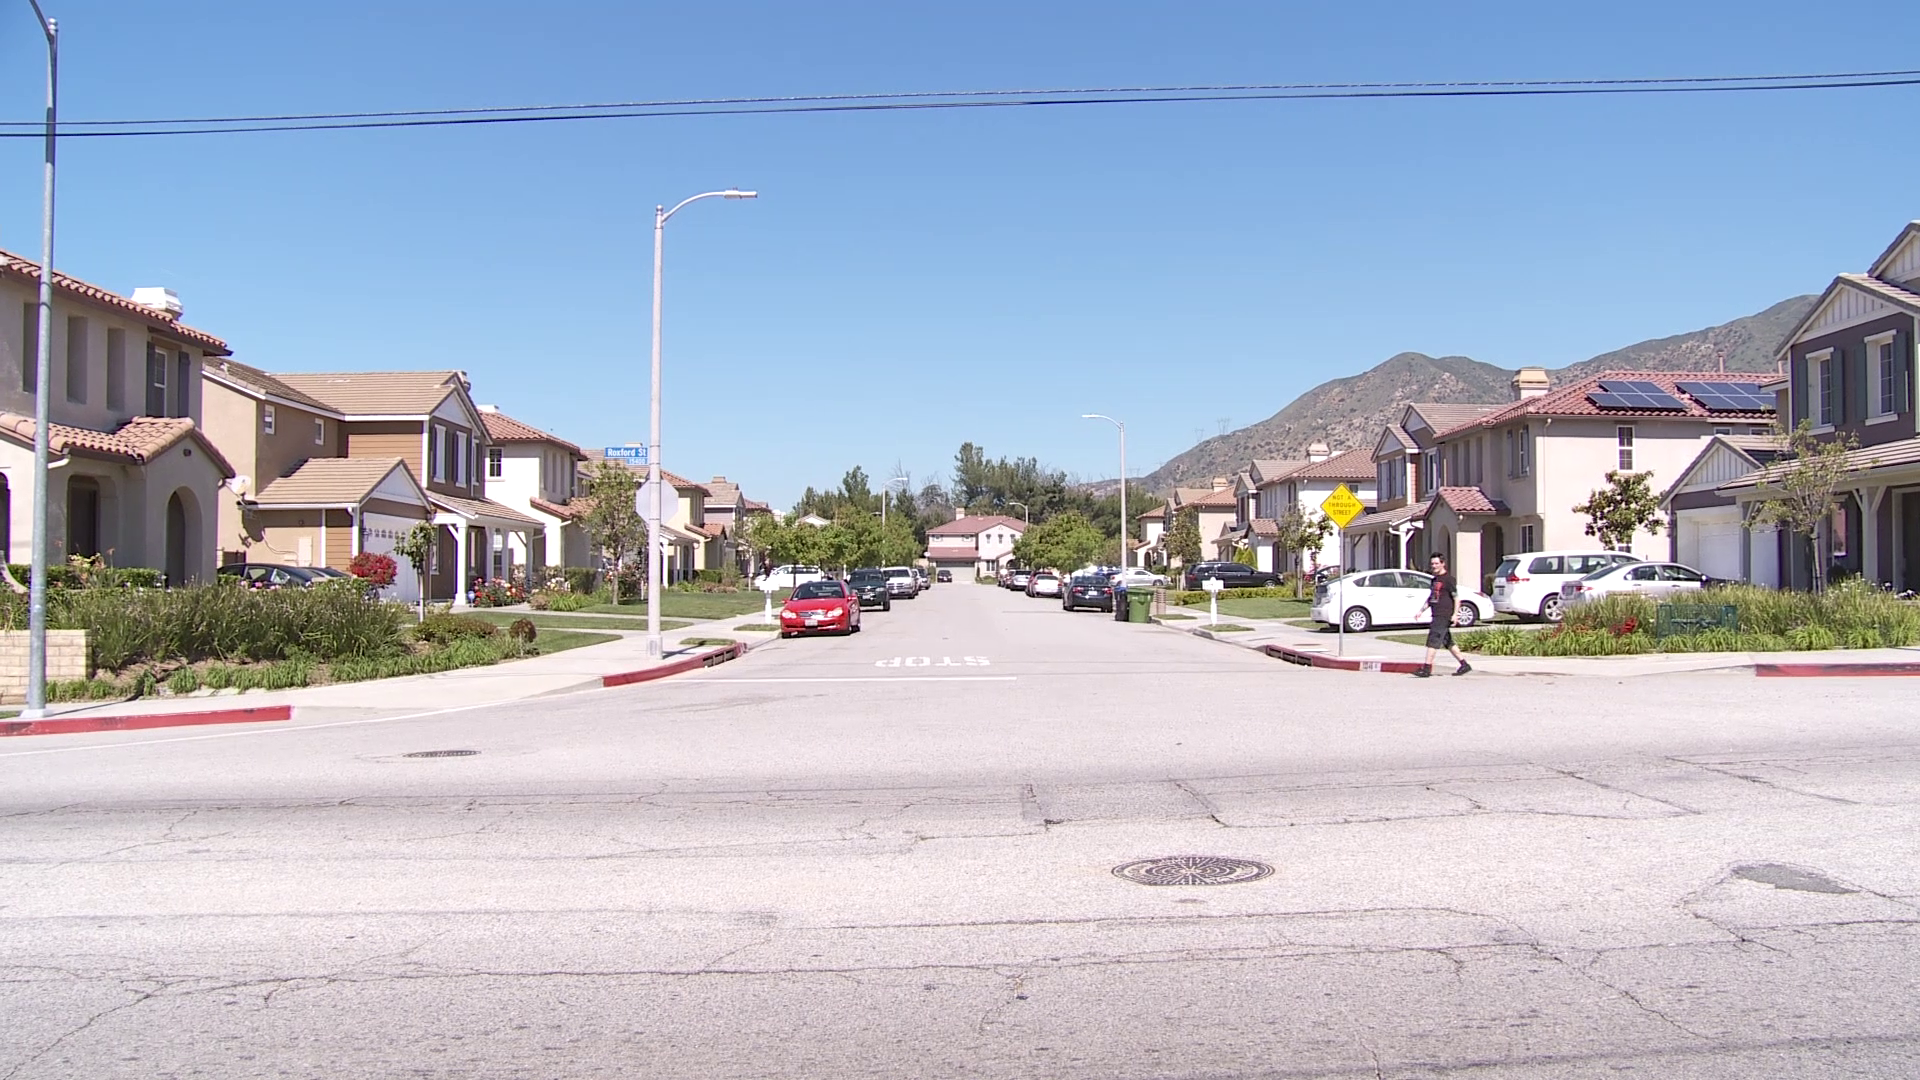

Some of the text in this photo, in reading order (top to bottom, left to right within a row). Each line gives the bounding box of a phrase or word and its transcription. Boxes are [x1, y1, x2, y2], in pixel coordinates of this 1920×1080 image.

[607, 448, 647, 457] Roxford St
[874, 656, 991, 667] STOP
